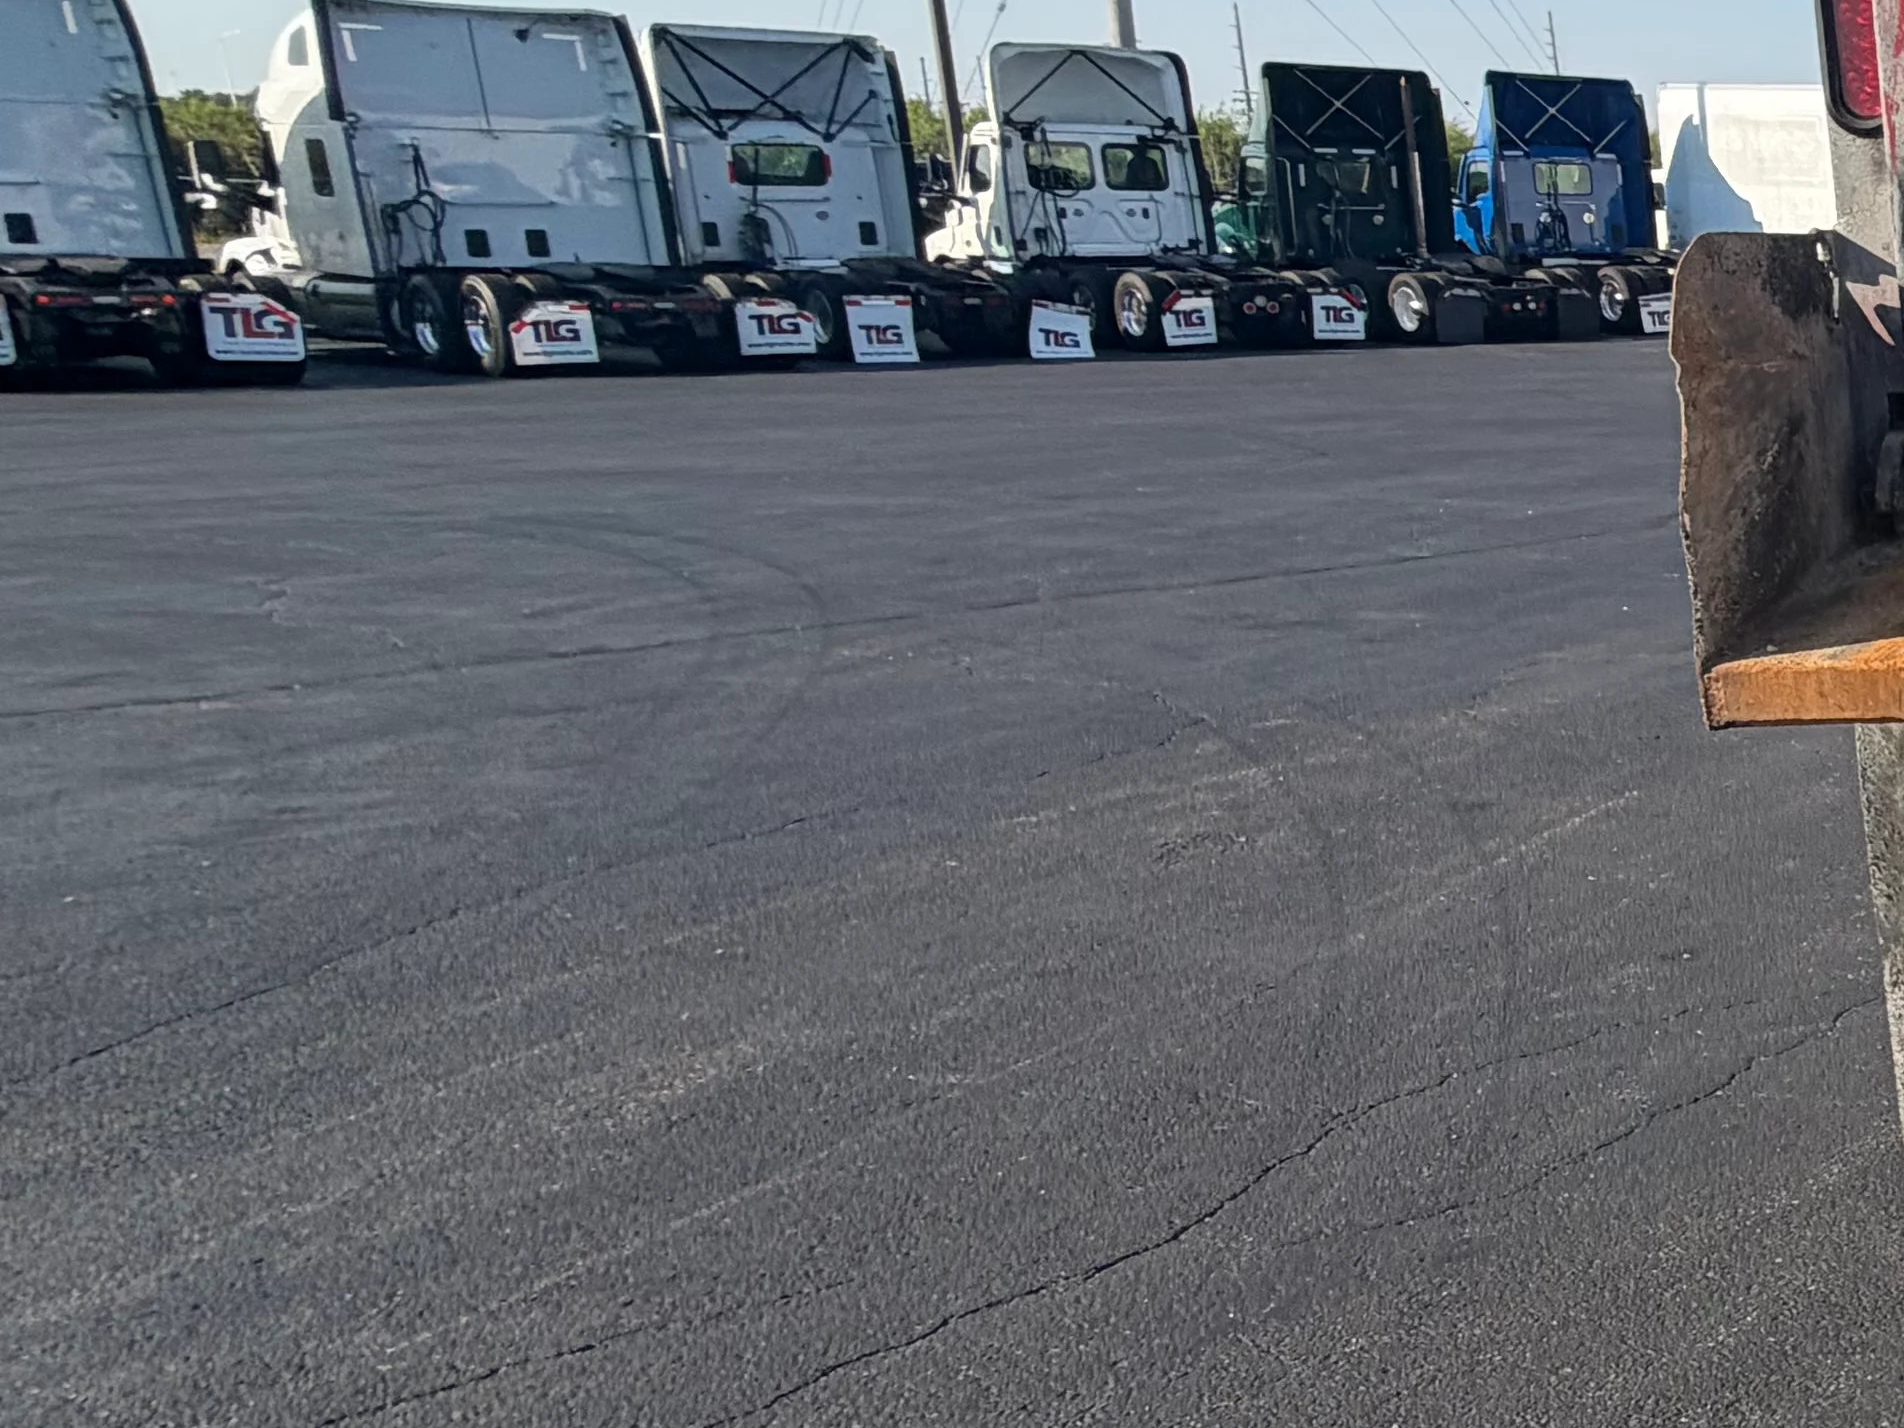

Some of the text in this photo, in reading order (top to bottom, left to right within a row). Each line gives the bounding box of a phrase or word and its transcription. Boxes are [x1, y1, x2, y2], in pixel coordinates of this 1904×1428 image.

[208, 306, 295, 339] TLG
[748, 314, 802, 335] TLG
[1169, 309, 1206, 328] TLG
[1320, 305, 1355, 323] TLG
[527, 319, 581, 343] TLG
[857, 324, 904, 344] TLG
[1038, 327, 1081, 348] TLG
